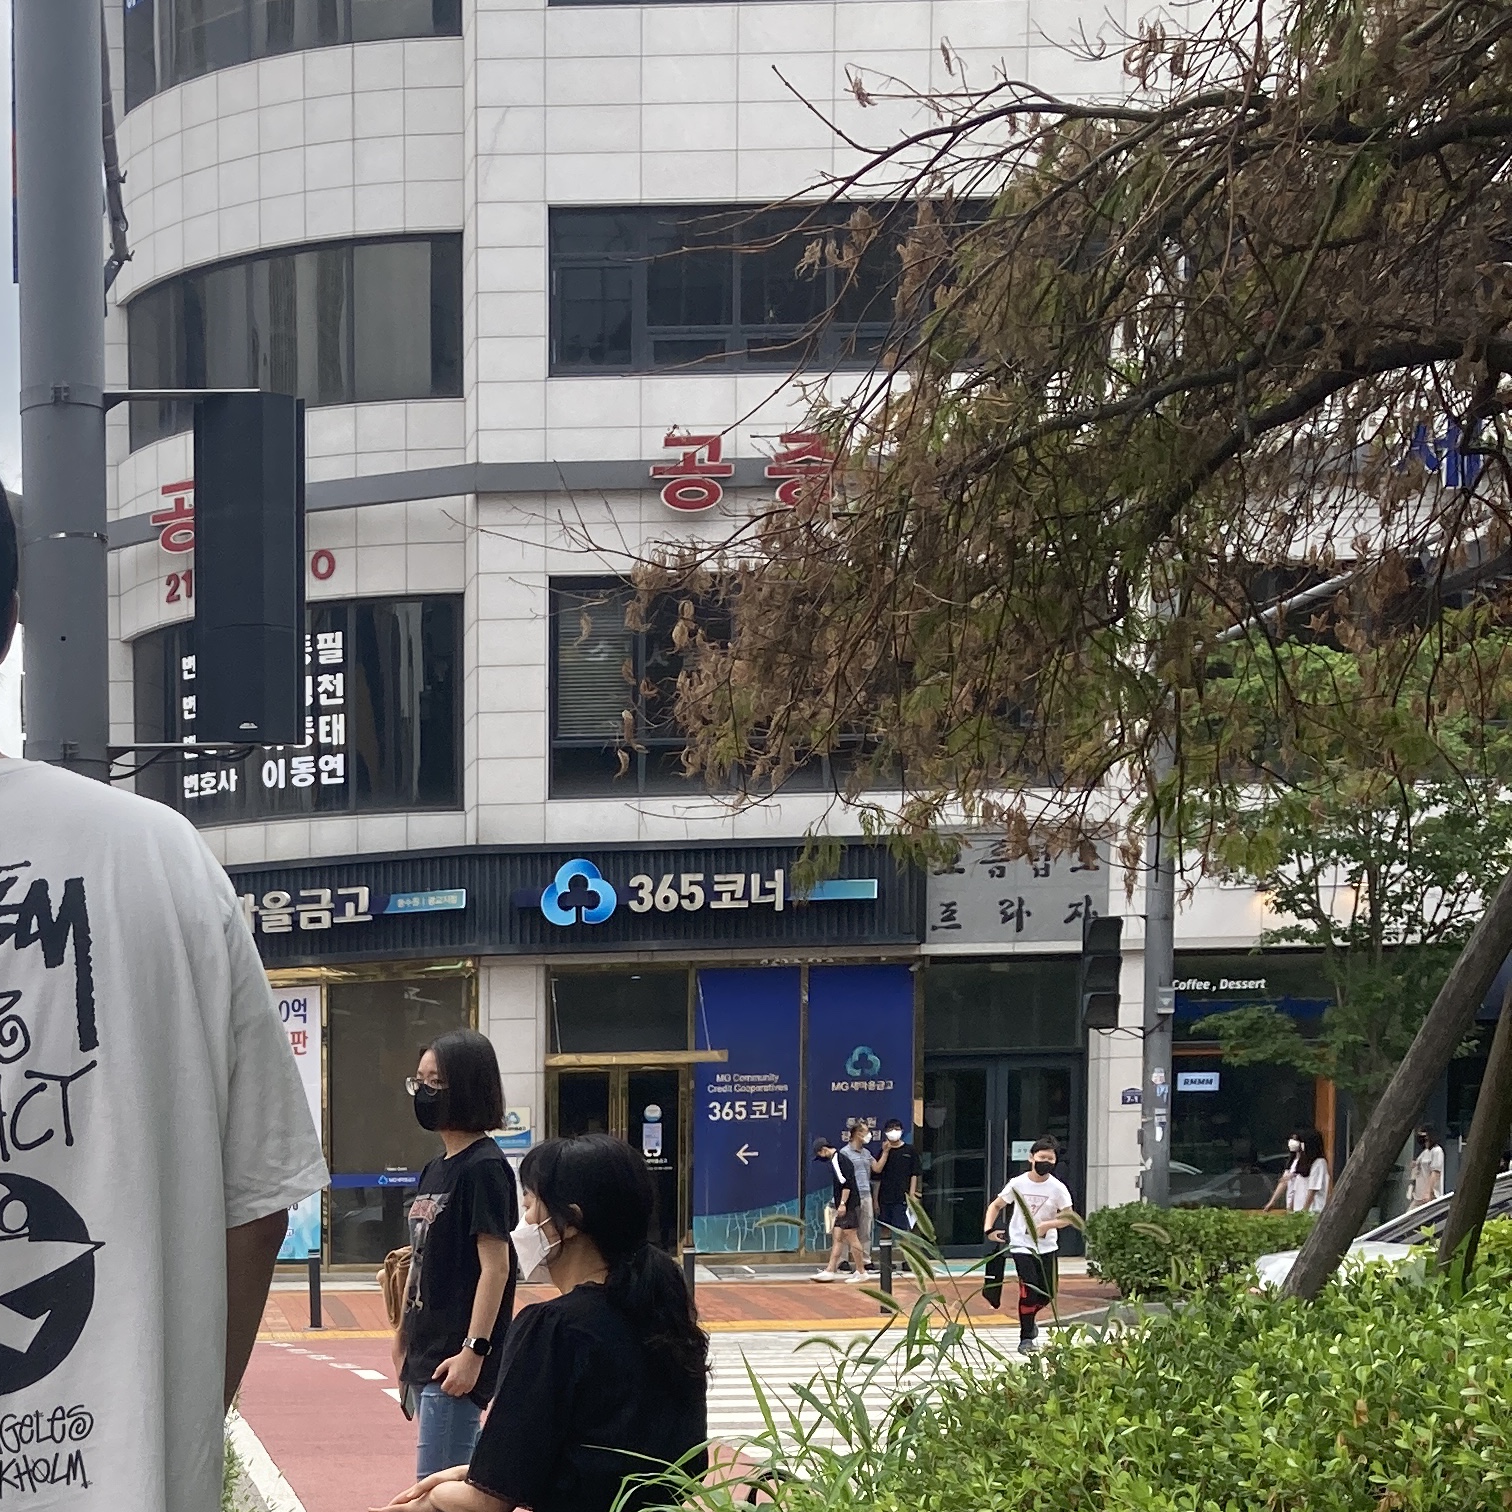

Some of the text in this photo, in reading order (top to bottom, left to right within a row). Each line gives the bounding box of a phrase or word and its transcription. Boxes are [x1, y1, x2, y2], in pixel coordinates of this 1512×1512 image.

[183, 753, 345, 799] 변호사 이동연
[1219, 977, 1268, 991] Dessert
[732, 1072, 780, 1084] Community
[707, 1083, 789, 1094] Credit Cooperatives
